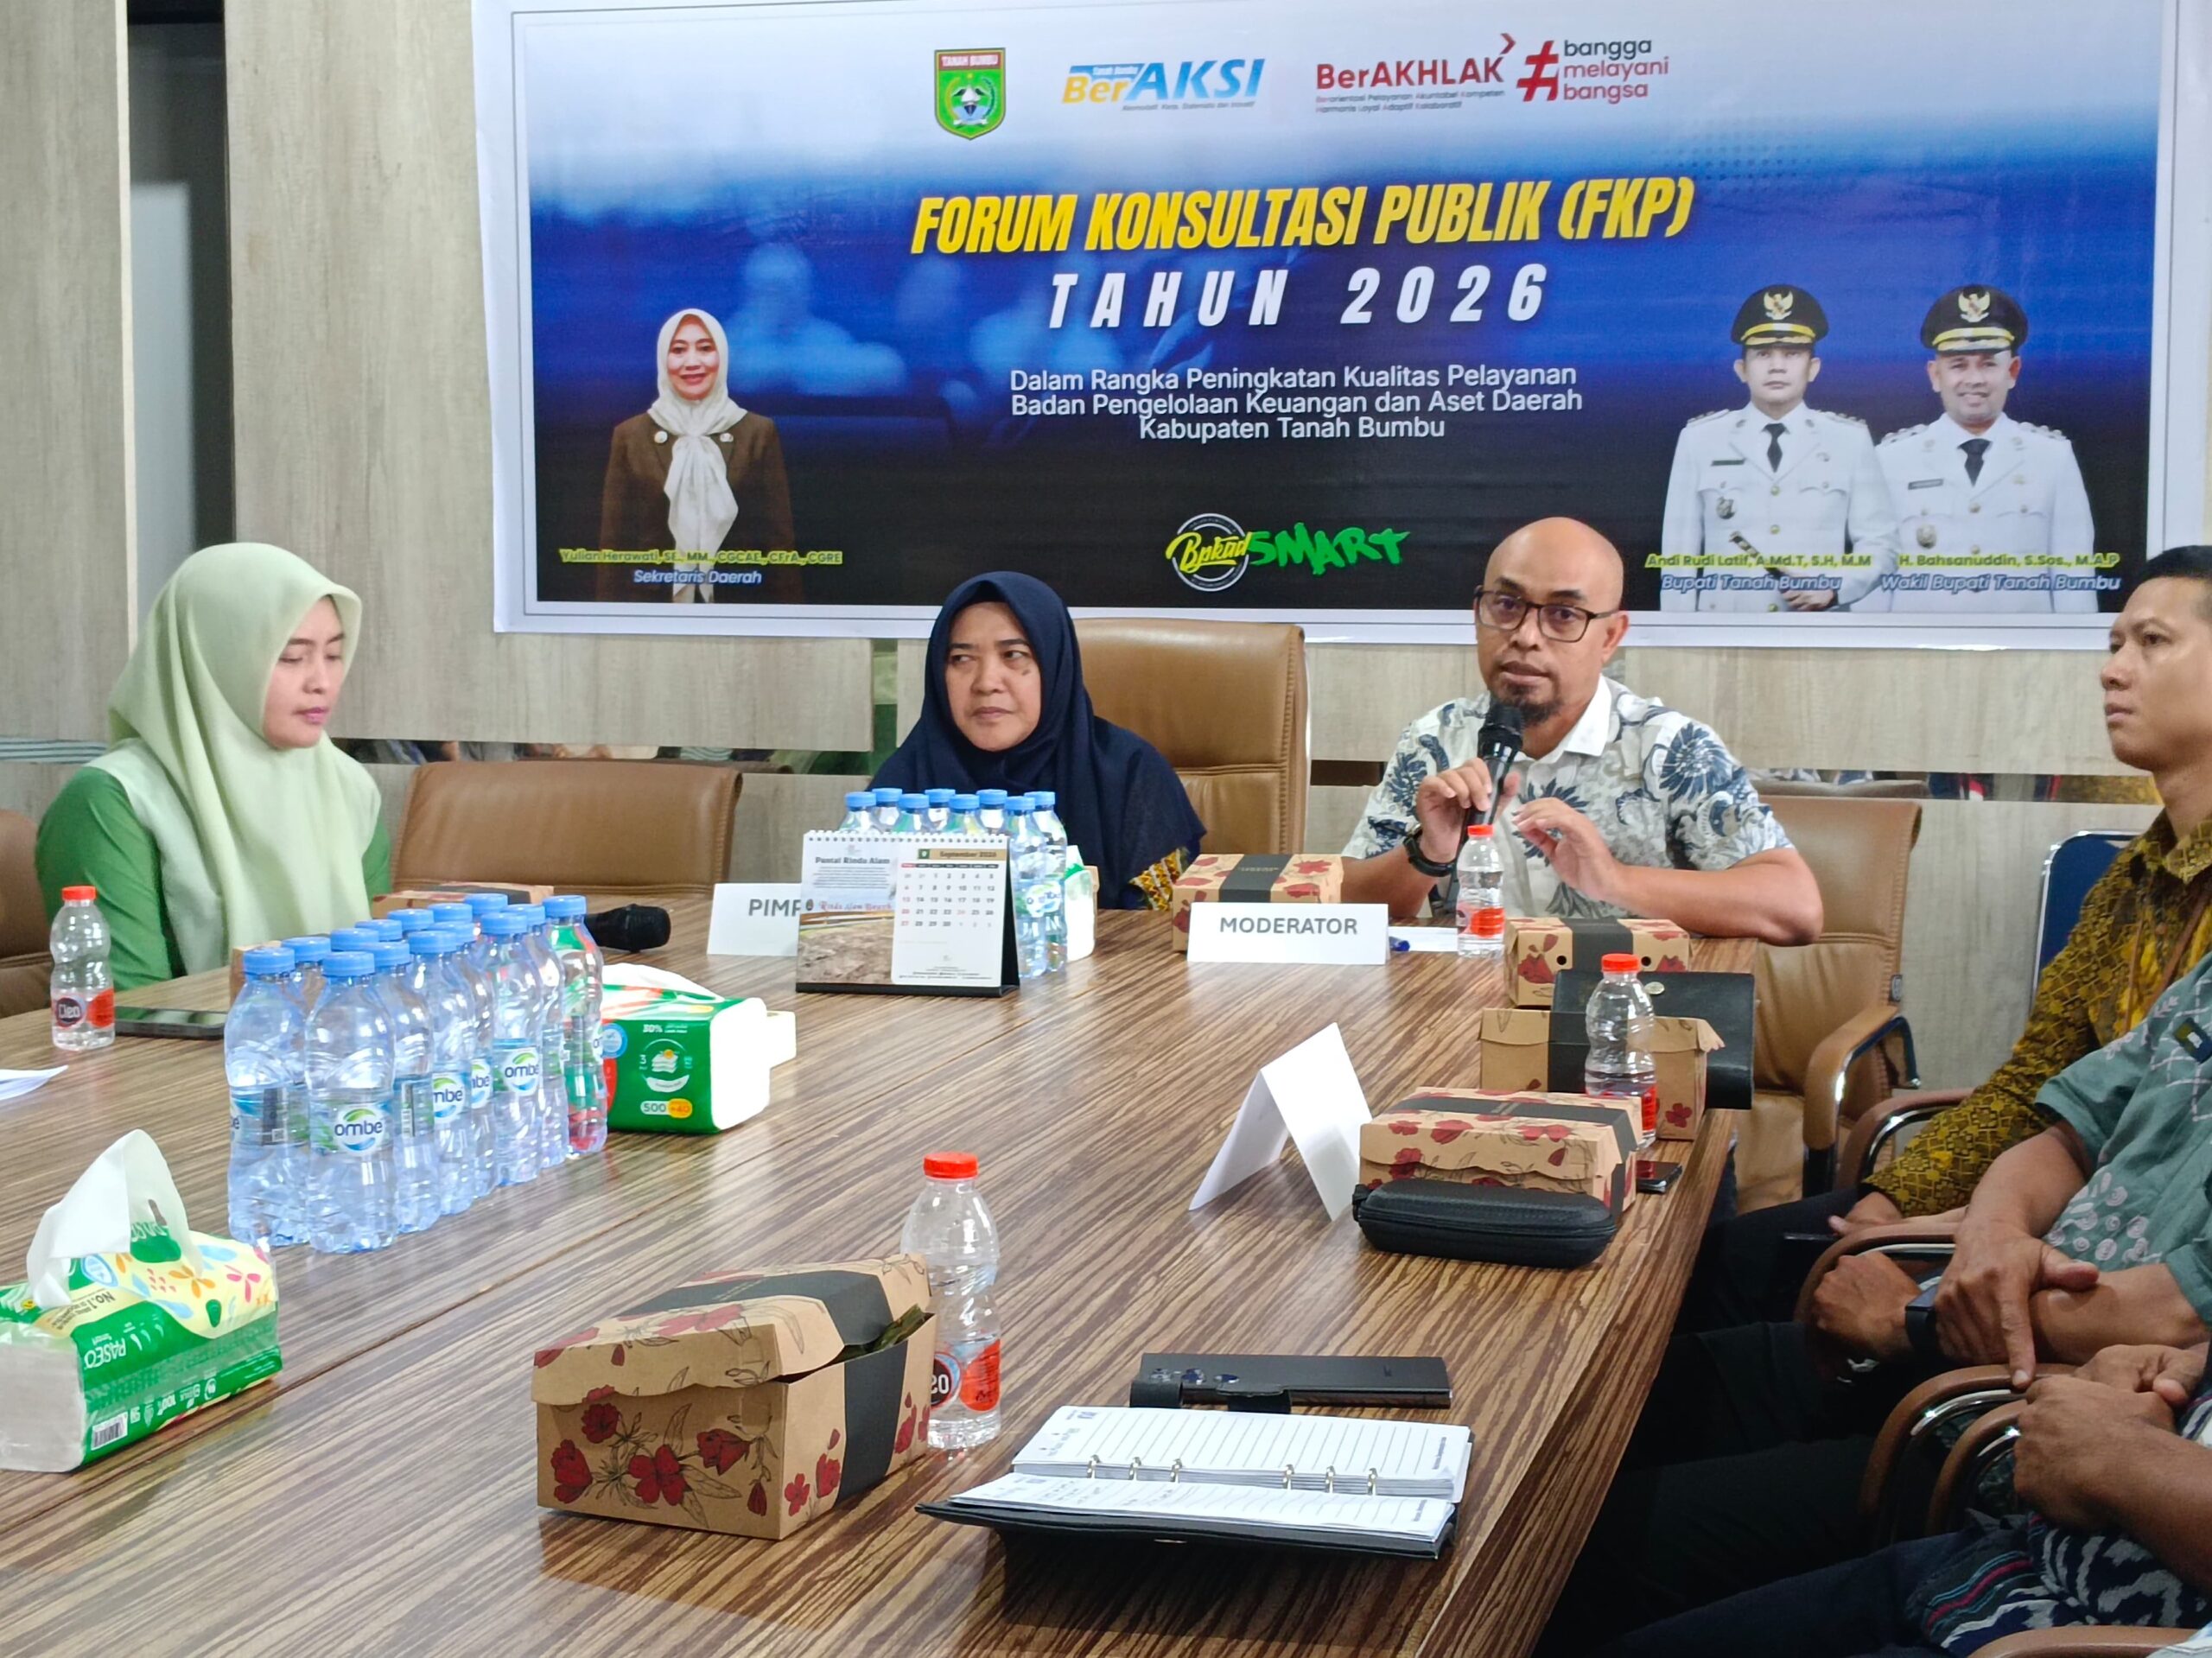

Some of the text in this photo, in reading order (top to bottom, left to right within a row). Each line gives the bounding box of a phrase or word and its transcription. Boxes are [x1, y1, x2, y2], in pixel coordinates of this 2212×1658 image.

[1564, 39, 1652, 60] bangga
[1316, 55, 1504, 90] BerAKHLAK
[1564, 56, 1669, 82] melayani
[1564, 80, 1649, 104] bangsa
[911, 176, 1695, 254] FORUM KONSULTASI PUBLIK (FKP)
[1049, 263, 1548, 328] TAHUN 2026
[1010, 364, 1577, 395] Dalam Rangka Peningkatan Kualitas Pelayanan
[1011, 389, 1583, 419] Badan Pengelolaan Keuangan dan Aset Daerah
[1140, 416, 1446, 444] Kabupaten Tanah Bumbu
[1249, 522, 1411, 575] SMART
[1646, 554, 1680, 567] Andi
[1683, 554, 1714, 566] Rudi
[1898, 554, 1914, 566] H.
[633, 569, 762, 584] Sekretaris Daerah
[1661, 574, 1843, 594] Bupati Tanah Bumbu
[1880, 573, 2122, 594] Wakil Bupati Tanah Bumbu
[939, 850, 977, 859] September
[748, 899, 801, 917] PIMP
[1219, 917, 1358, 935] MODERATOR
[433, 1089, 463, 1103] mbe
[334, 1118, 383, 1137] ombe
[86, 1290, 116, 1310] No.1
[84, 1337, 126, 1369] PASEO
